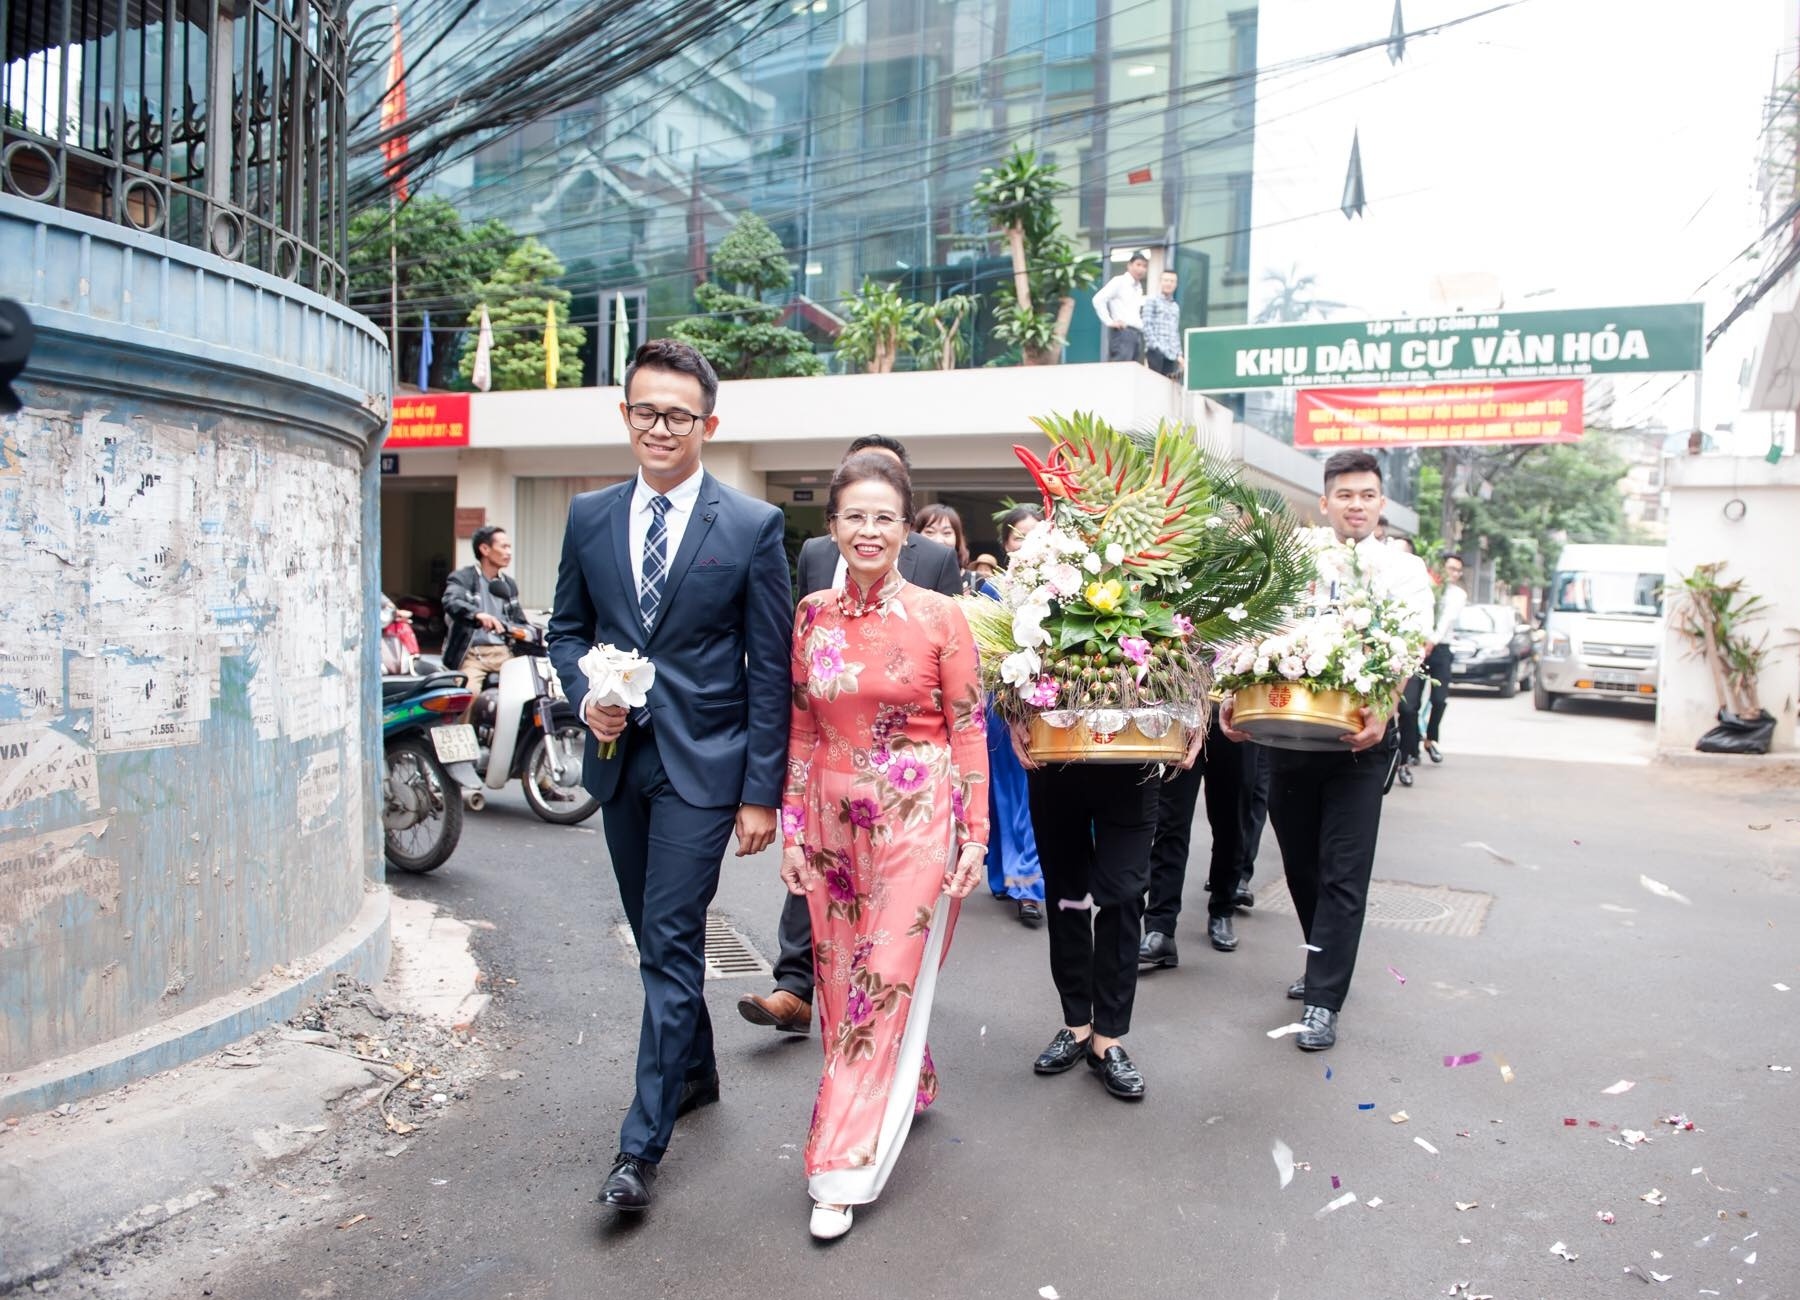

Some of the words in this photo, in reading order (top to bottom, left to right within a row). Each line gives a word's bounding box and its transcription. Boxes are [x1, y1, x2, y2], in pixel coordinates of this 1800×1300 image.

[1235, 347, 1308, 377] KHU
[1315, 338, 1392, 373] DÂN
[1400, 336, 1460, 369] CƯ
[1471, 329, 1555, 366] VĂN
[1562, 323, 1650, 362] HÓA
